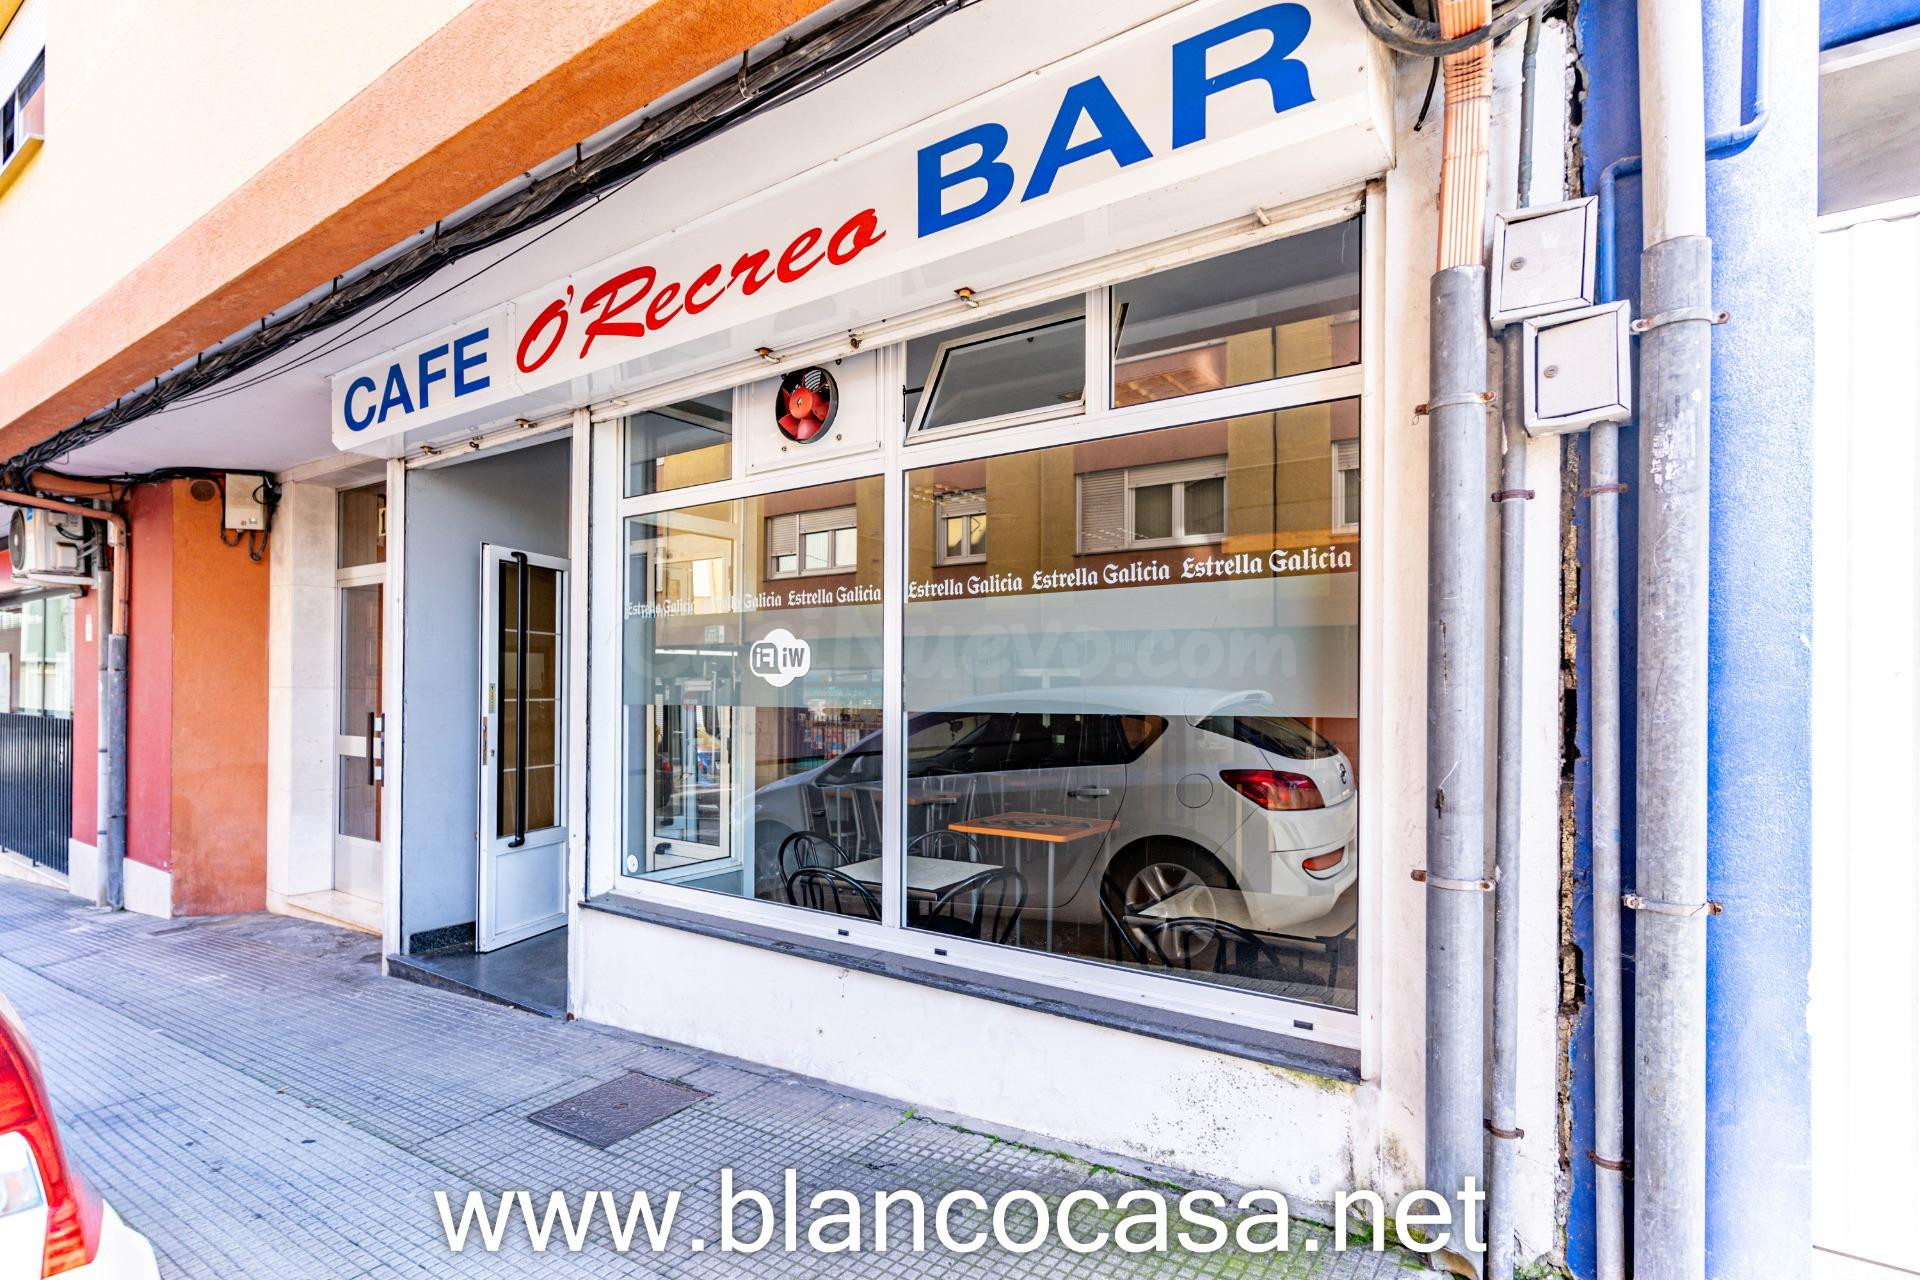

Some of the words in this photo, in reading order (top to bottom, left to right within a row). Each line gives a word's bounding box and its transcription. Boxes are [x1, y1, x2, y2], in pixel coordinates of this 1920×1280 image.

[343, 327, 491, 432] CAFE
[515, 208, 886, 374] O'Recreo
[917, 2, 1317, 239] BAR
[788, 589, 833, 606] Estrella
[836, 585, 881, 603] Galicia
[908, 580, 963, 599] Estrella
[967, 573, 1022, 594] Galicia
[1032, 567, 1098, 590] Estrella
[1103, 560, 1170, 583] Galicia
[1181, 553, 1263, 579] Estrella
[1269, 546, 1352, 572] Galicia
